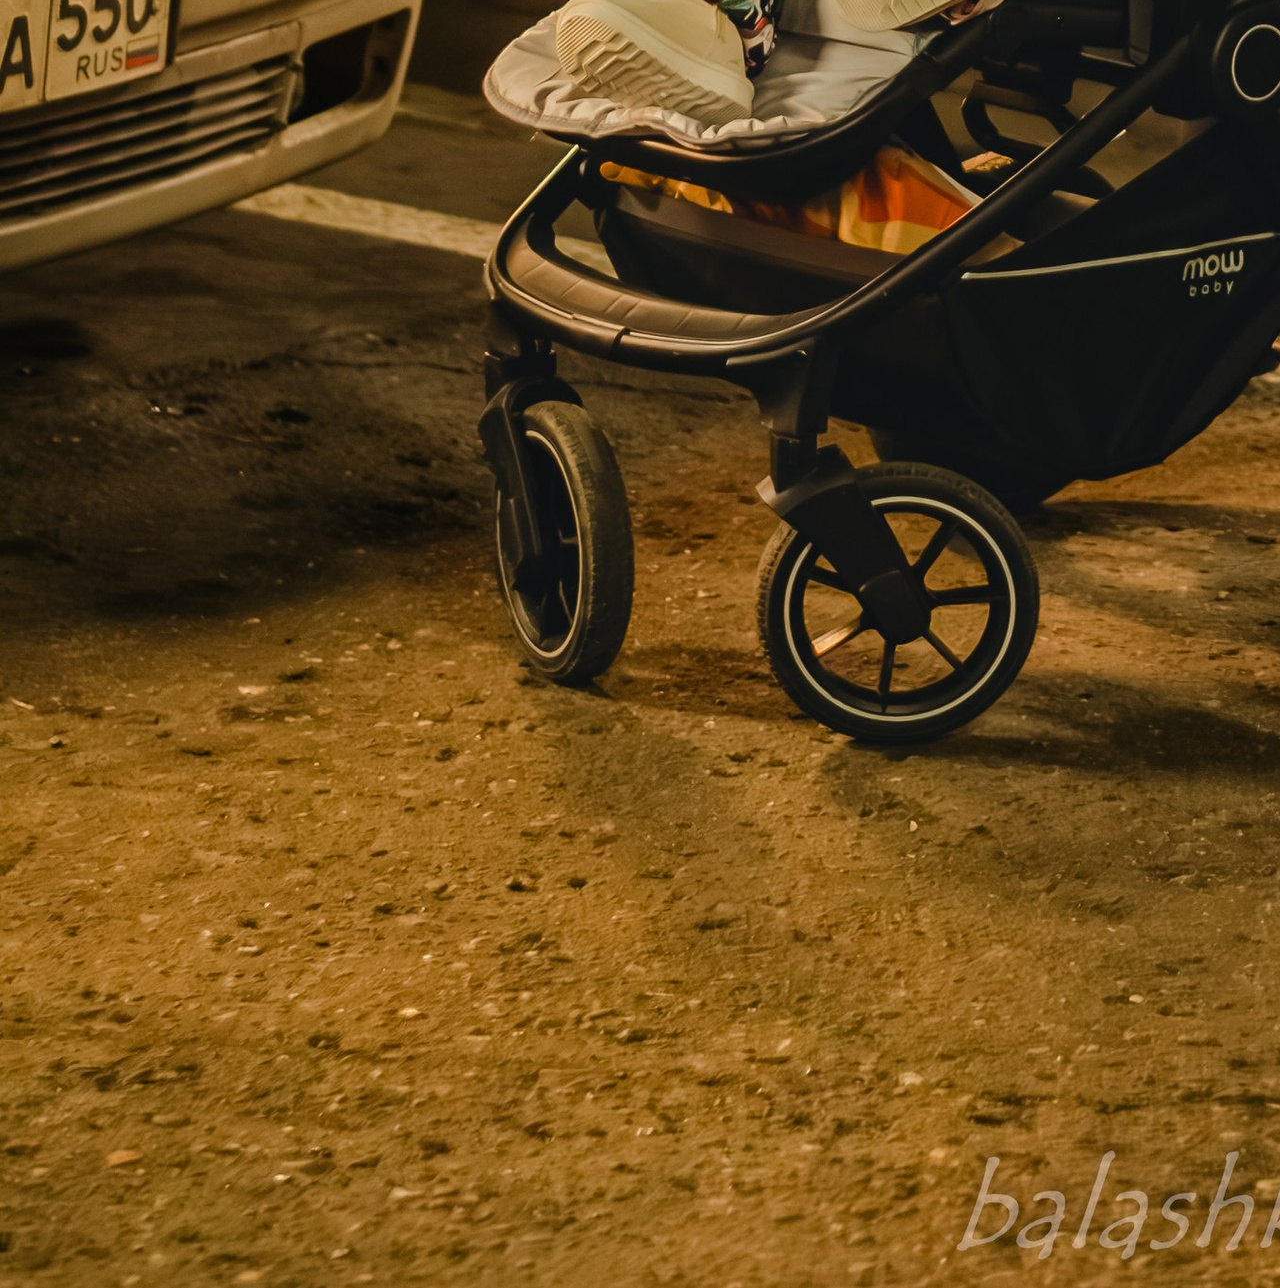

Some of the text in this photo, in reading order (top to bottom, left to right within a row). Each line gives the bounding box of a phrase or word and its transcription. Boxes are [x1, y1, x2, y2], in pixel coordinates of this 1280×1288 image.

[76, 47, 124, 83] RUS
[1182, 249, 1244, 281] mow
[1189, 280, 1234, 297] baby
